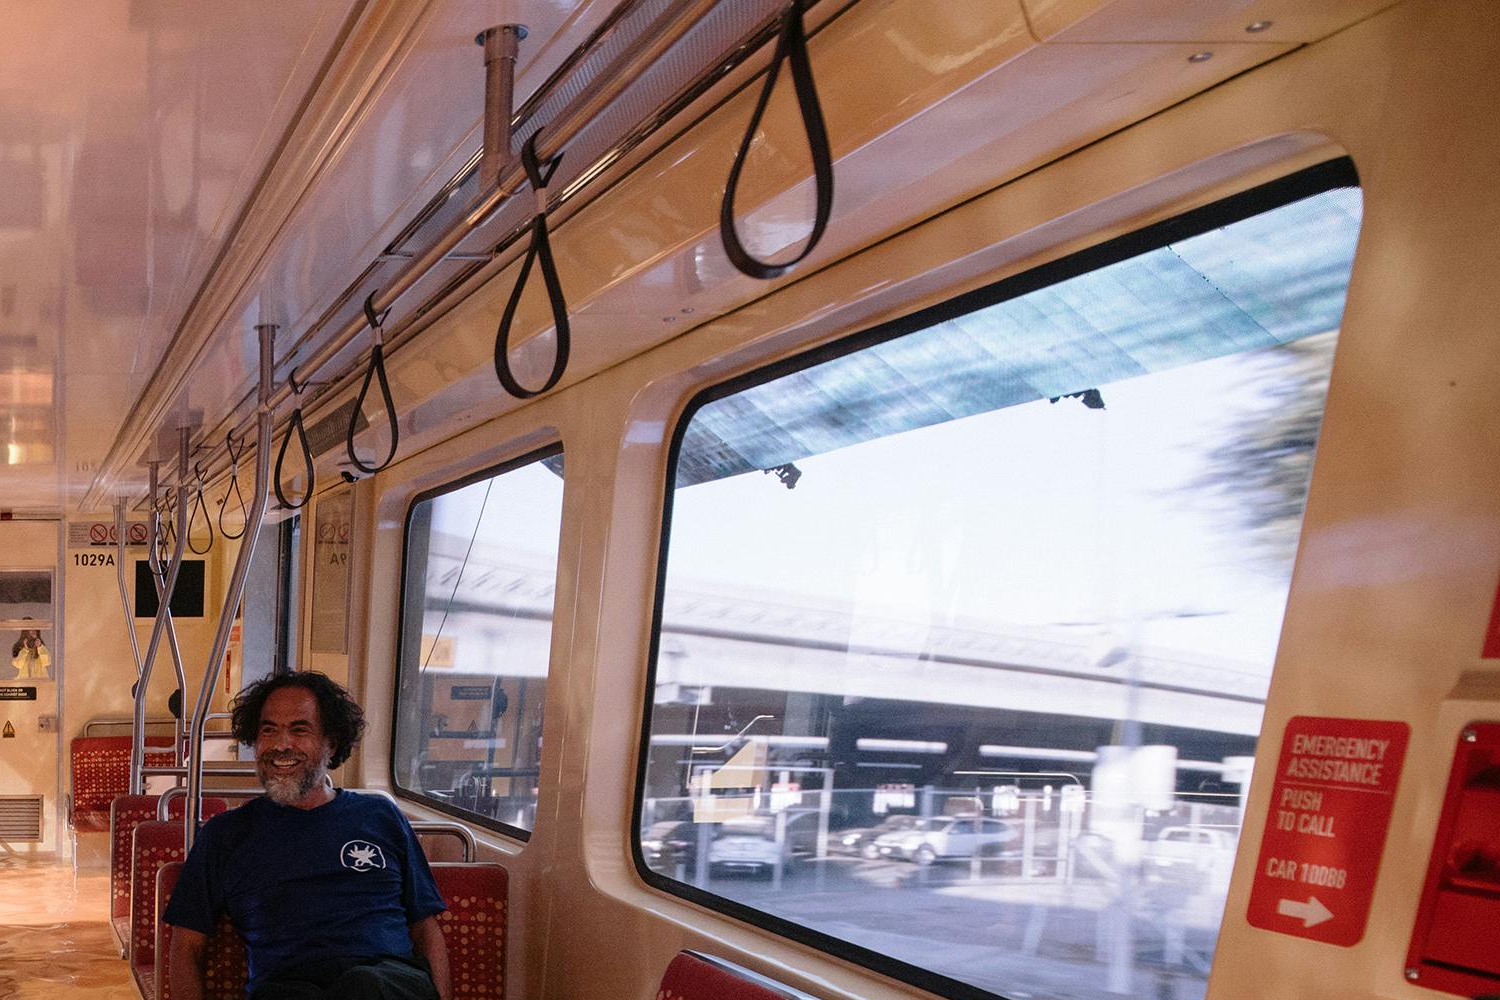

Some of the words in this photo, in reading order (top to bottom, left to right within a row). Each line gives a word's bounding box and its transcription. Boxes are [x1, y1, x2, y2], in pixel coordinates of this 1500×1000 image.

[74, 553, 115, 566] 1029A
[1292, 734, 1390, 761] EMERGENCY
[1287, 756, 1384, 785] ASSISTANCE
[1280, 788, 1323, 811] PUSH
[1276, 810, 1296, 831] TO
[1298, 813, 1336, 837] CALL
[1266, 857, 1297, 881] CAR
